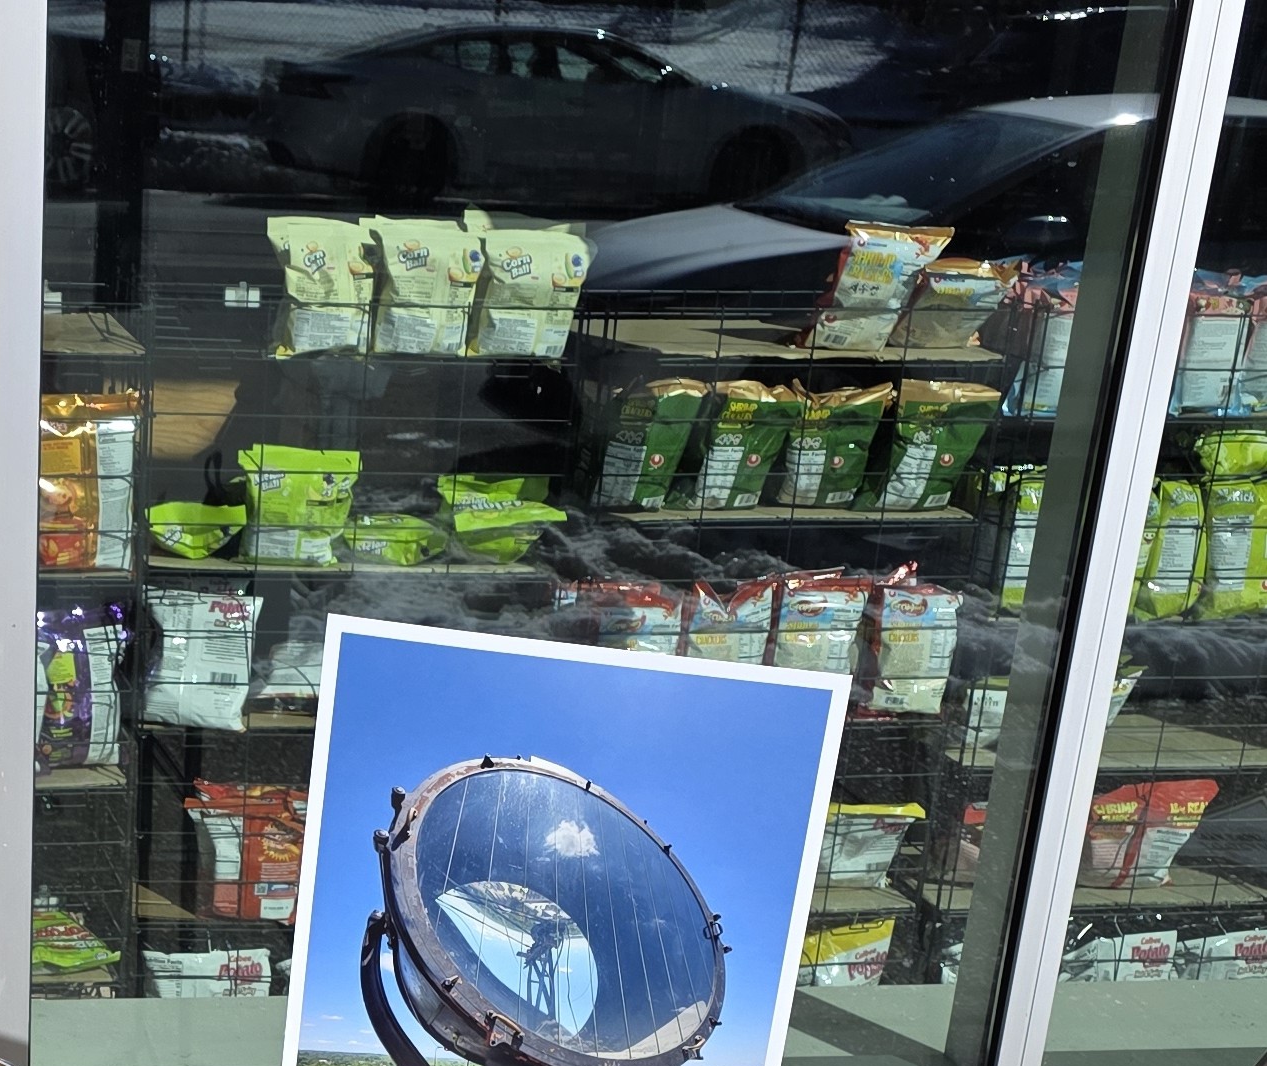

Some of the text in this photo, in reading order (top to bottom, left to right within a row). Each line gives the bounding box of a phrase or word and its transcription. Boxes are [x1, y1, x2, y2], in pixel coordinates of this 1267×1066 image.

[398, 247, 429, 264] Corn
[502, 254, 532, 272] Corn
[406, 257, 427, 271] Ball
[510, 265, 531, 280] Ball
[1093, 801, 1139, 815] SHRIMP
[1131, 944, 1170, 961] Potato
